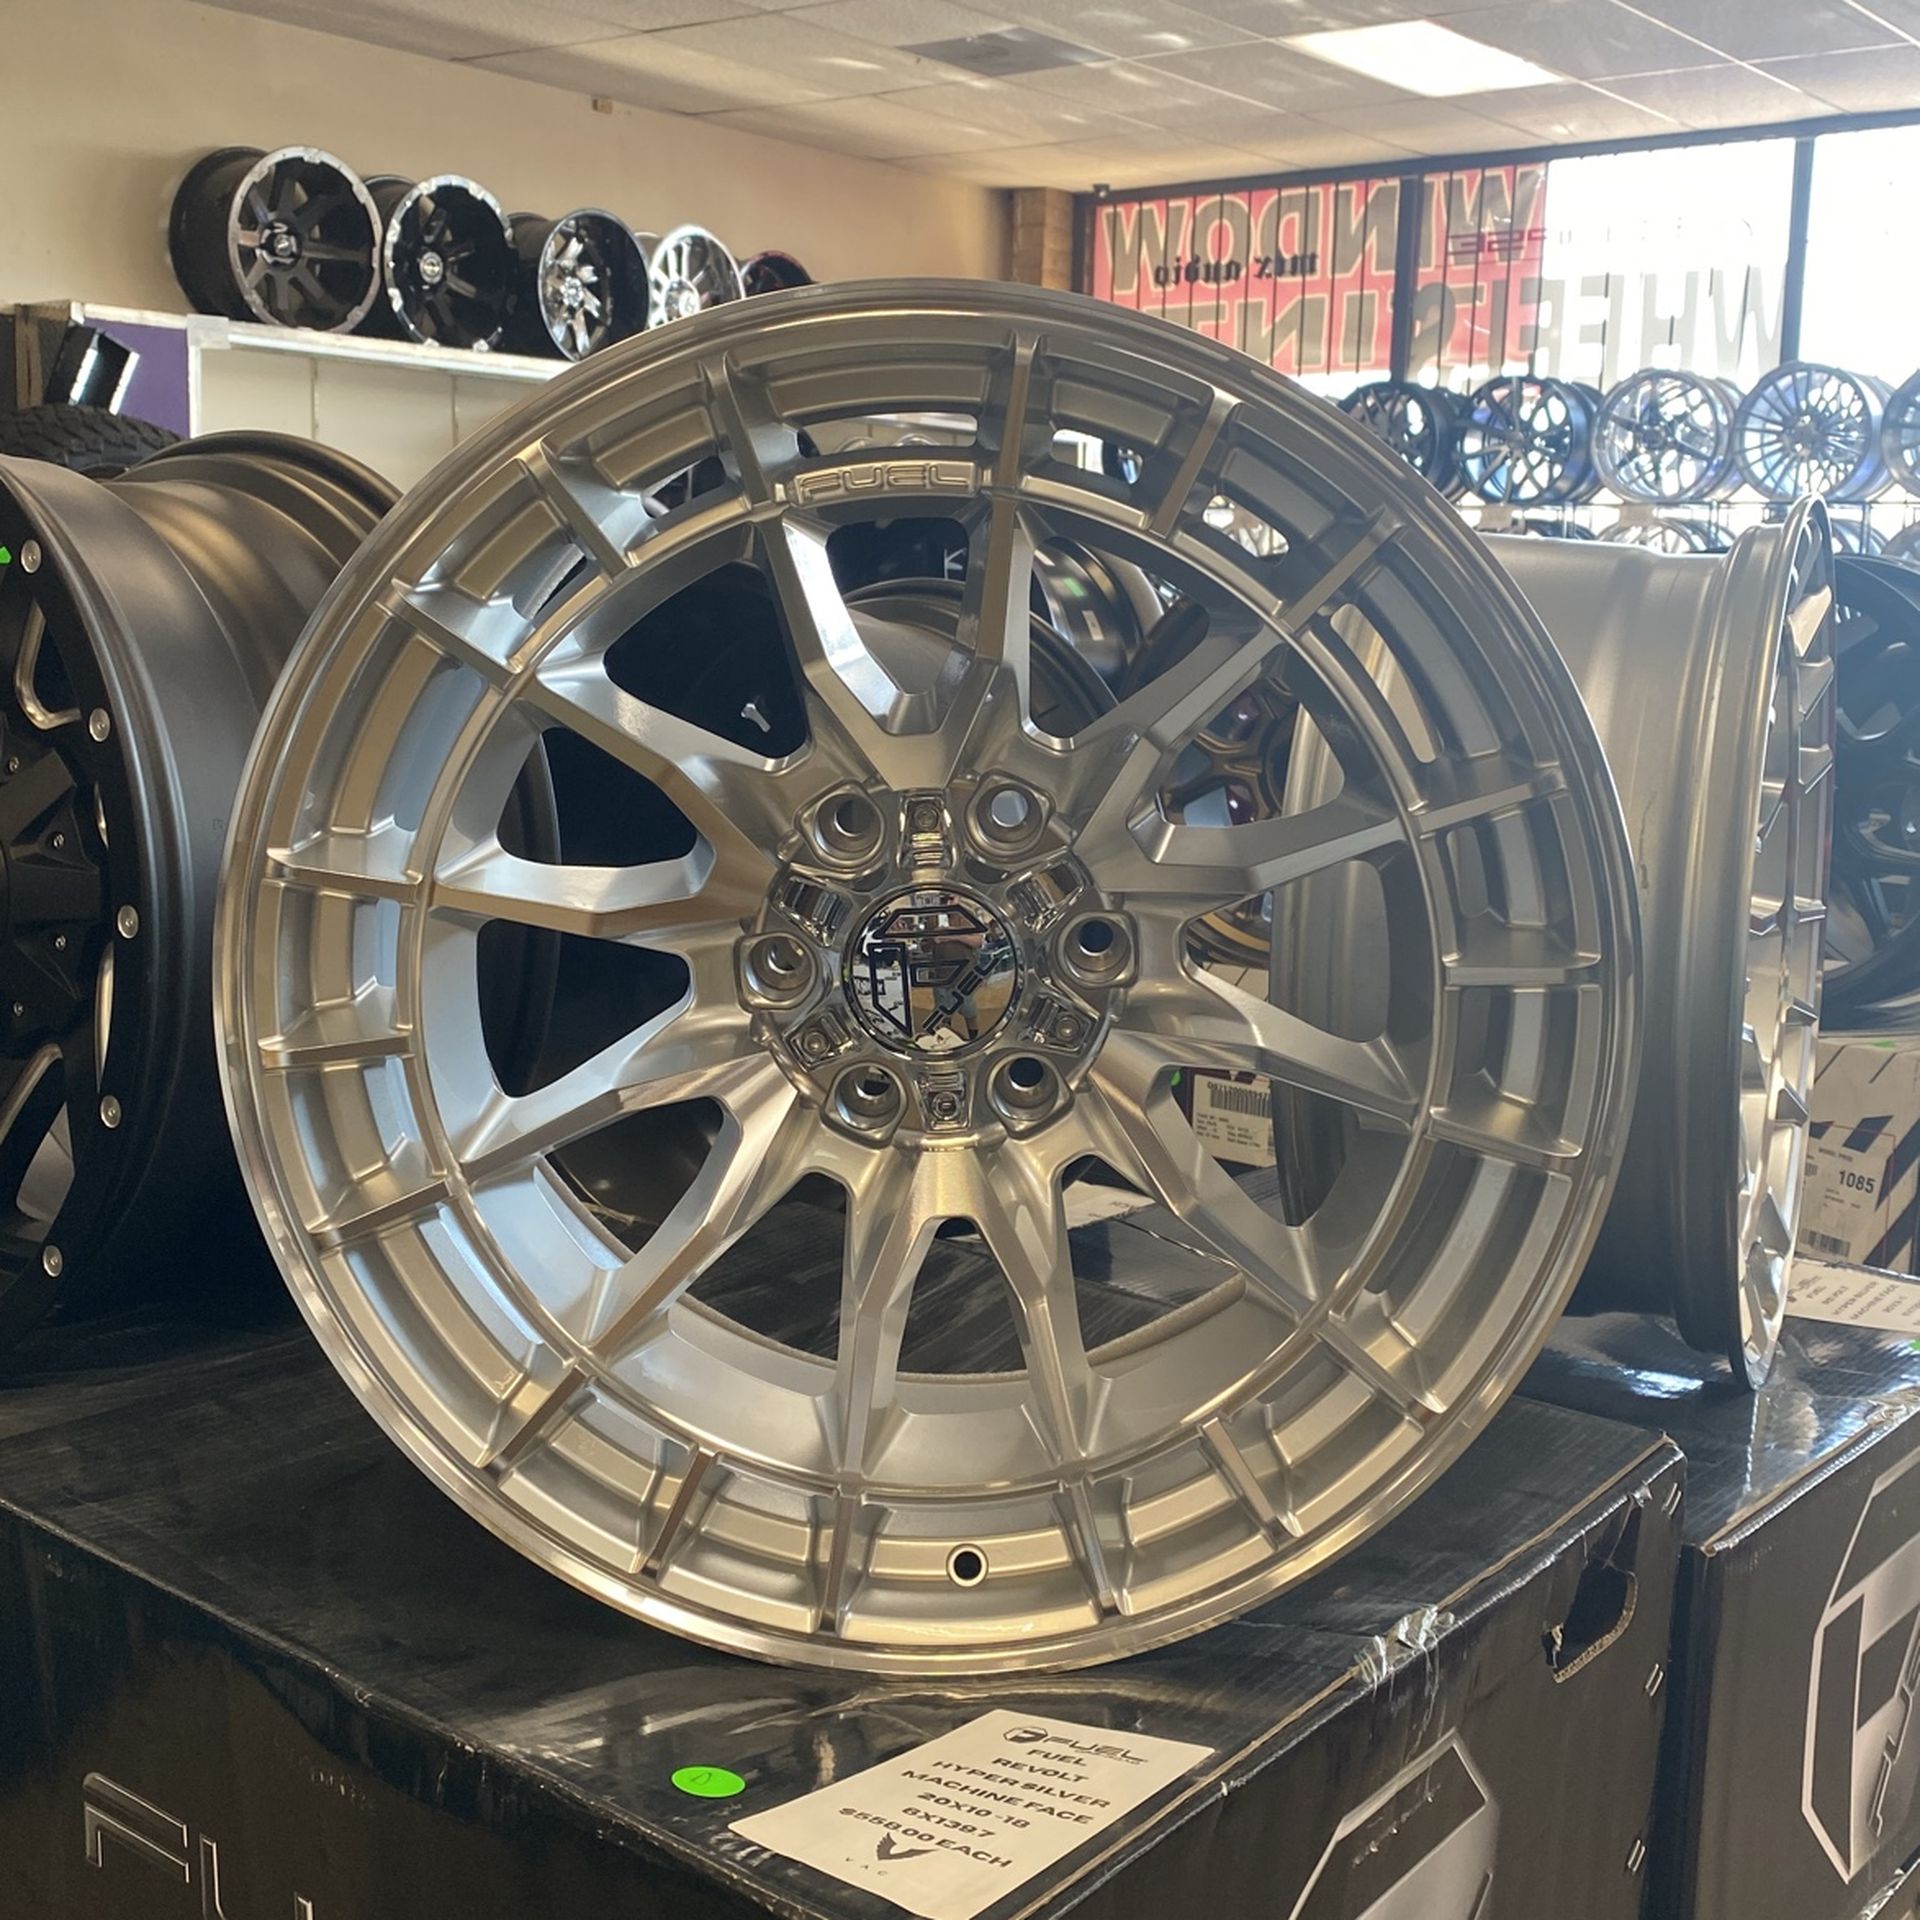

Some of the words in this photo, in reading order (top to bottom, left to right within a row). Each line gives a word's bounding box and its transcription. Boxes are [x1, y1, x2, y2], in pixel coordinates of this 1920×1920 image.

[800, 463, 970, 500] FUEL
[1839, 1169, 1877, 1194] 1085
[1027, 1749, 1087, 1767] FUEL
[1043, 1735, 1149, 1763] FUEL
[992, 1757, 1089, 1783] REVOLT
[901, 1770, 1024, 1806] MACHINE
[1023, 1801, 1095, 1825] FACE
[932, 1761, 1019, 1787] HYPER
[1020, 1782, 1111, 1809] SILVER
[917, 1791, 992, 1817] 20X10
[935, 1838, 1013, 1868] EACH
